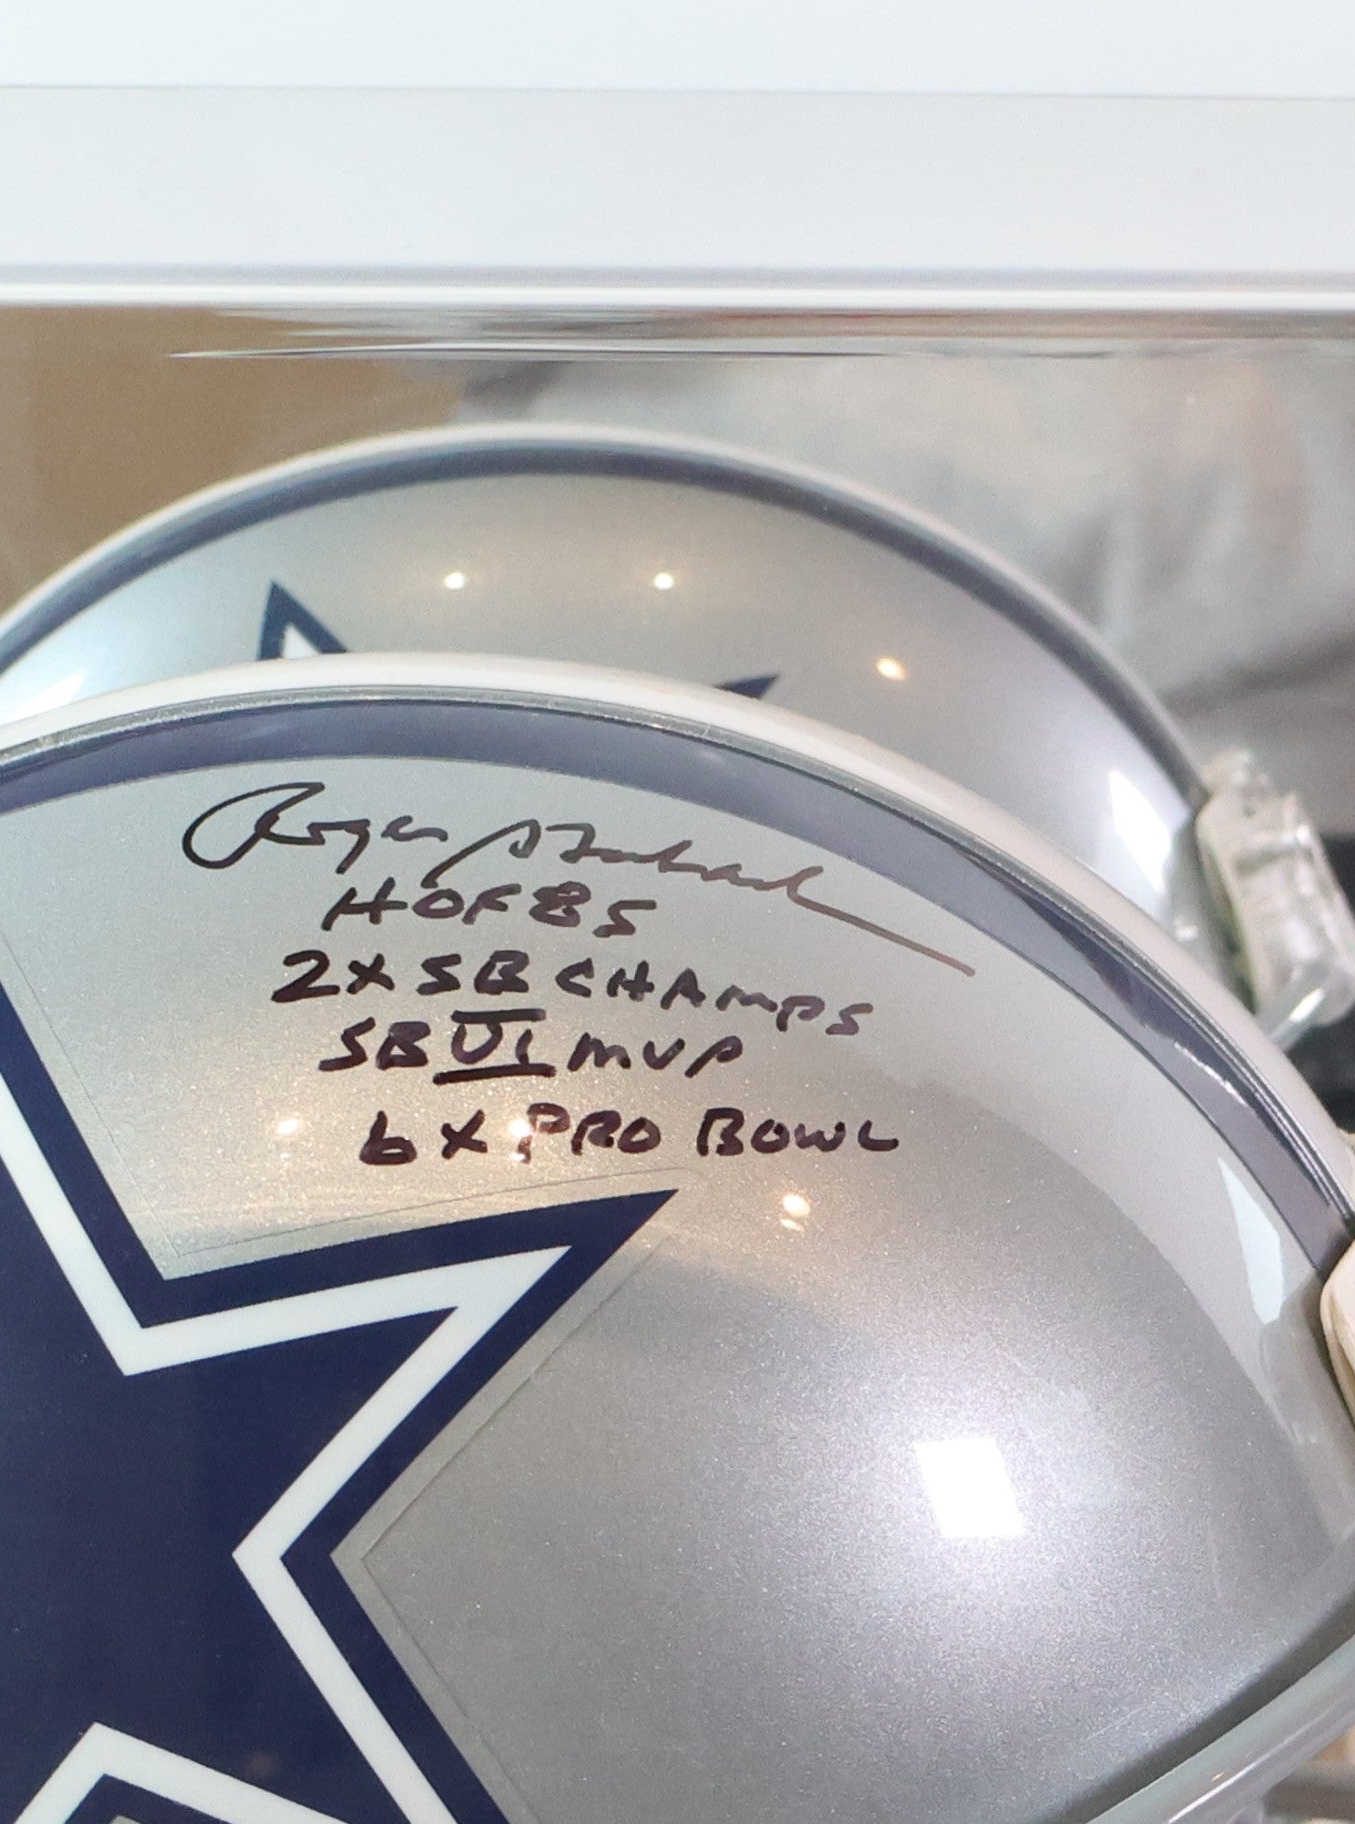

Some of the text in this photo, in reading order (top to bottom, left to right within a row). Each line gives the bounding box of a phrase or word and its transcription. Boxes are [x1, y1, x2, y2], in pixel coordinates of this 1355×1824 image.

[270, 948, 874, 1036] 2X SB CHAMPS
[317, 1016, 432, 1073] SB
[431, 1007, 558, 1087] VI
[515, 1101, 662, 1165] PRO
[695, 1106, 900, 1158] BOWL
